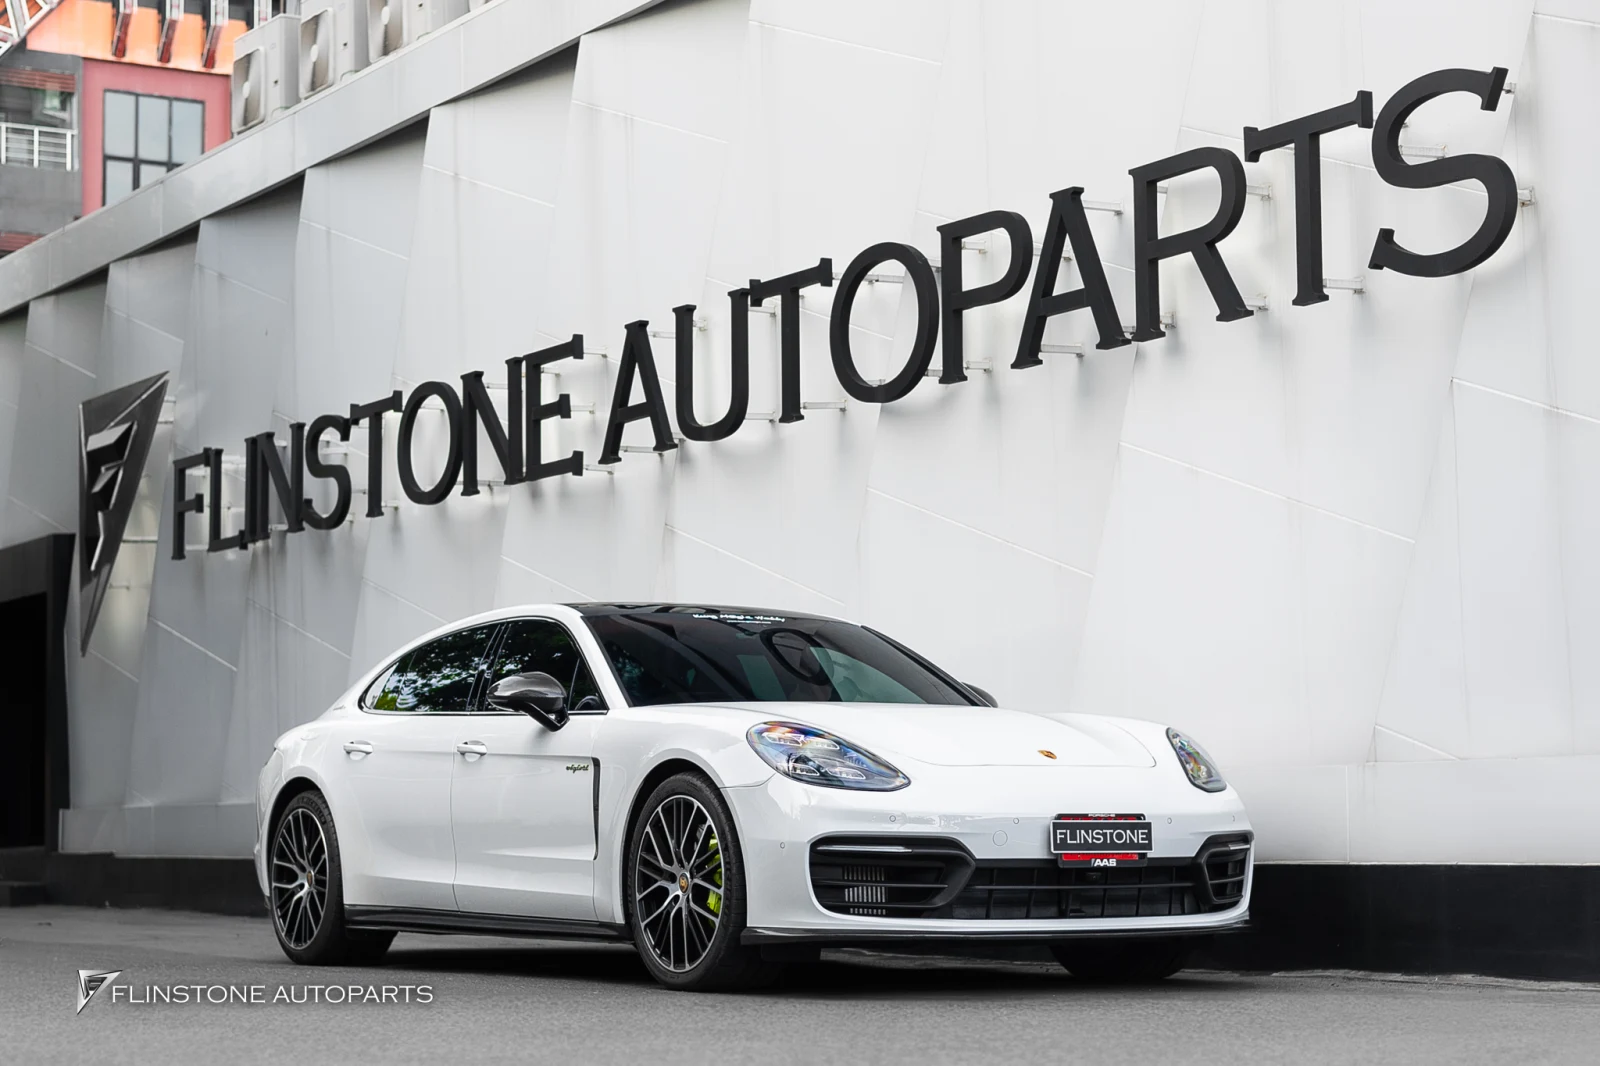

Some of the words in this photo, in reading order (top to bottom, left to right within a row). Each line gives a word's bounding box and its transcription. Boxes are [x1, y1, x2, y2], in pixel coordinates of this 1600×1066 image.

[171, 334, 584, 560] FLINSTONE
[599, 67, 1518, 464] AUTOPARTS
[1056, 829, 1149, 844] FLINSTONE
